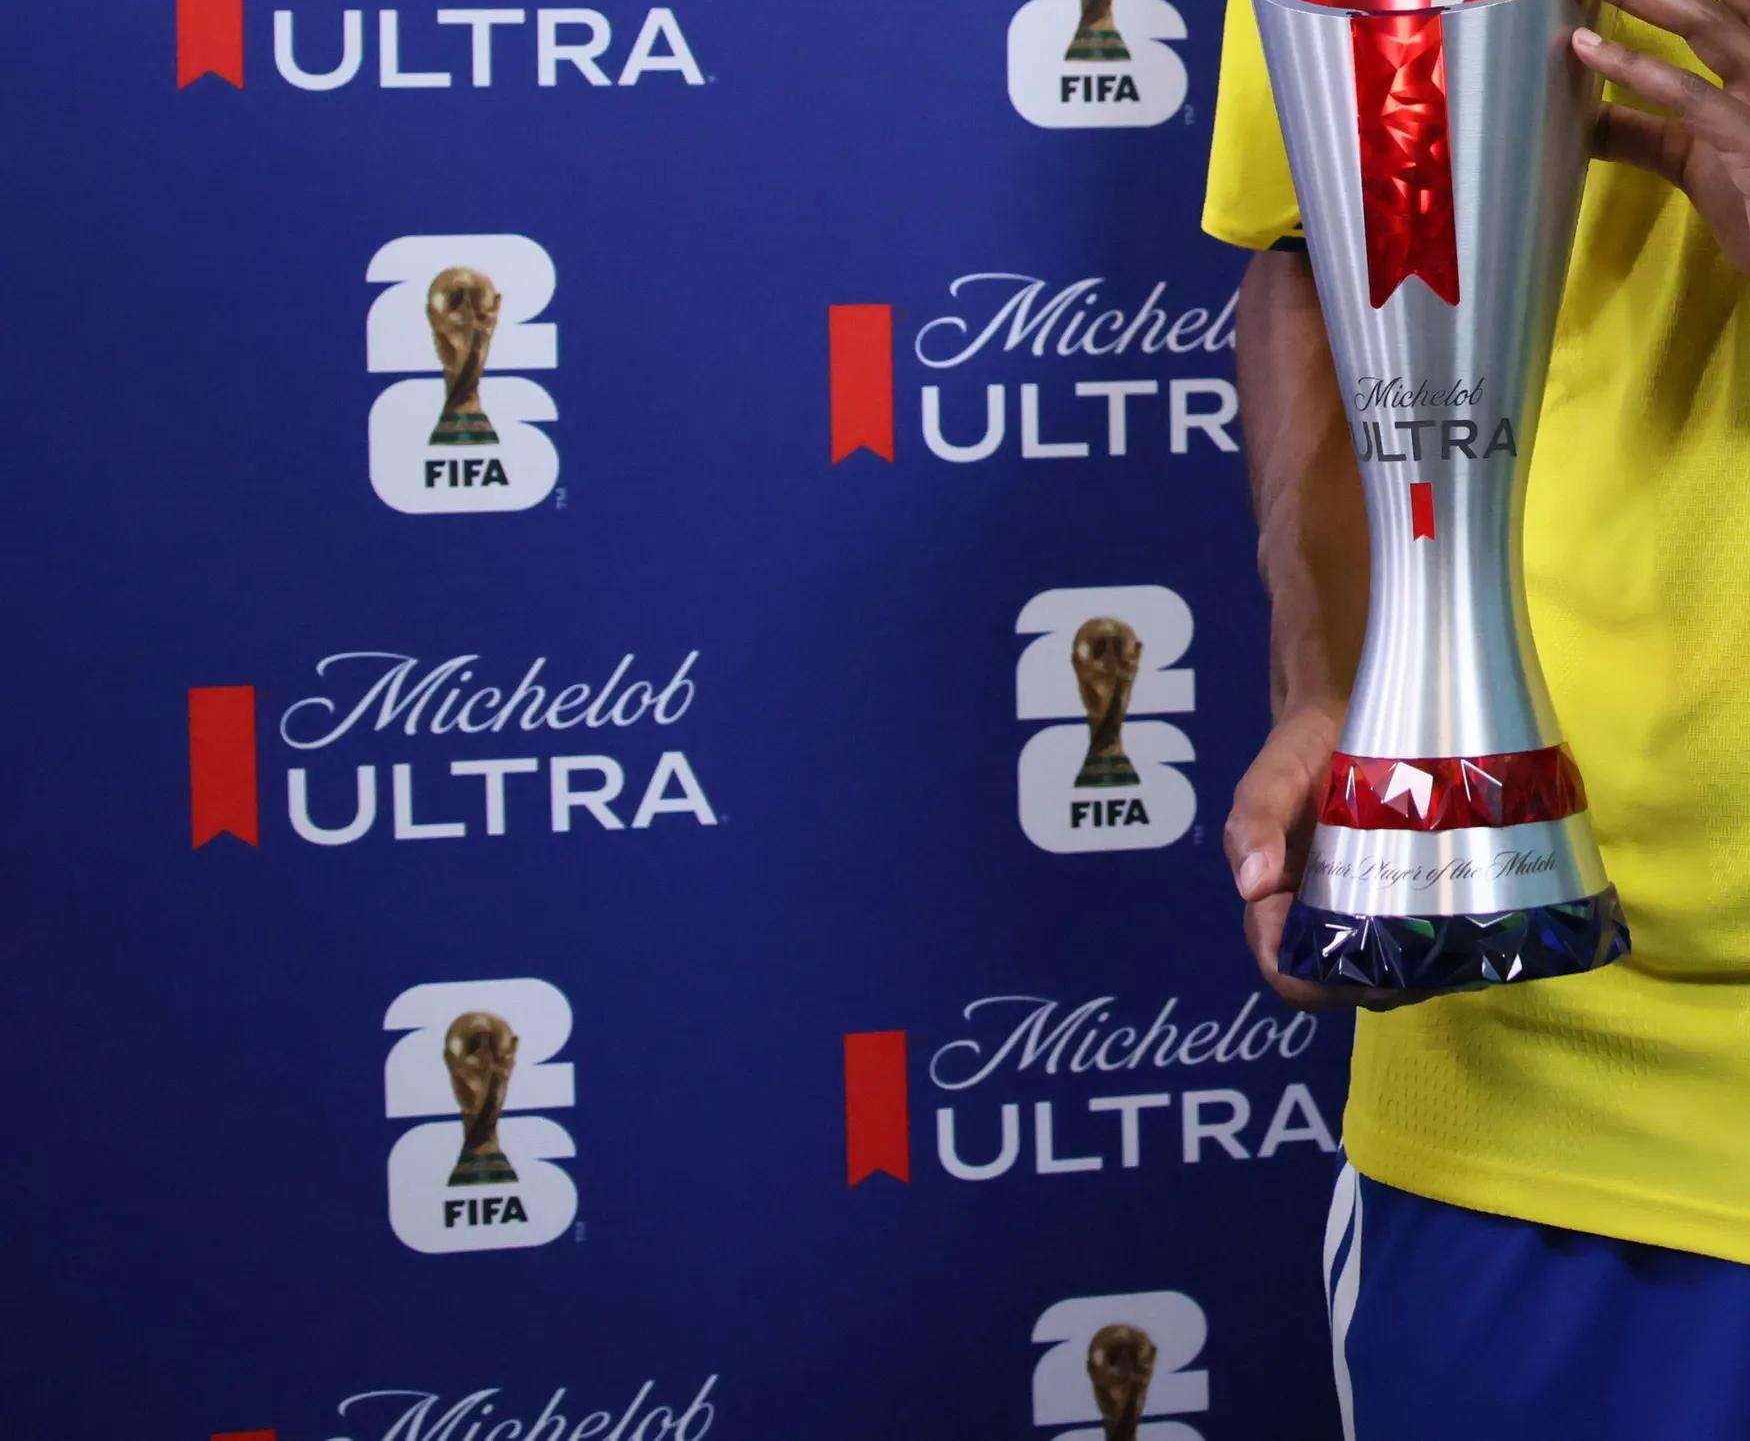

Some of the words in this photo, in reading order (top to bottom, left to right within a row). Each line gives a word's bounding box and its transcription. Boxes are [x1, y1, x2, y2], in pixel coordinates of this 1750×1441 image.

[273, 6, 706, 92] ULTRA
[1060, 73, 1141, 104] FIFA
[914, 272, 1240, 369] Michel
[920, 378, 1239, 464] ULTR
[1354, 375, 1486, 412] Michelob
[424, 457, 510, 489] FIFA
[279, 649, 700, 750] Michelob
[287, 750, 719, 846] ULTRA
[1070, 797, 1151, 830] FIFA
[936, 1083, 1337, 1181] ULTRA
[443, 1195, 529, 1229] FIFA
